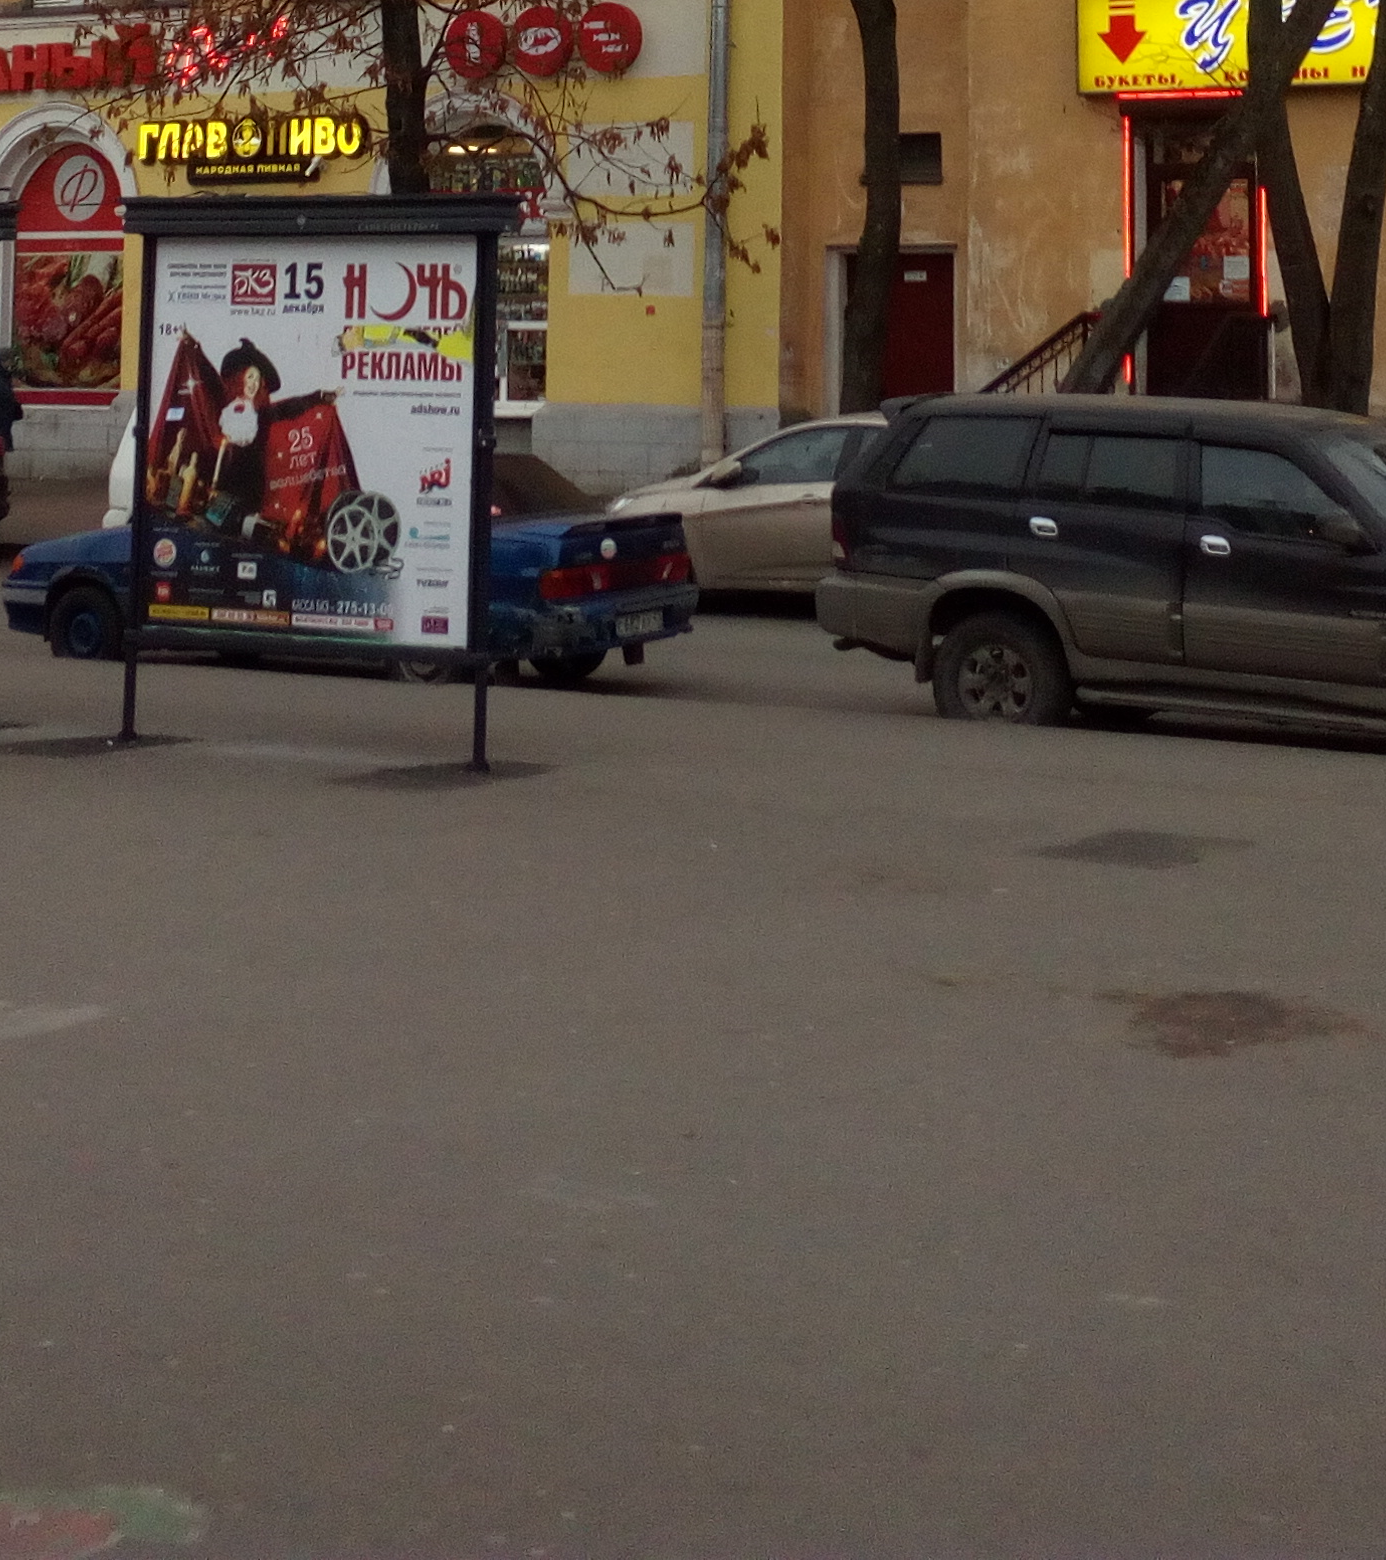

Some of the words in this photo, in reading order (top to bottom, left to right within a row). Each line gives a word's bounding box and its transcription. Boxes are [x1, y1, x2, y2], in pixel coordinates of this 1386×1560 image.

[1094, 72, 1183, 89] БУКЕТЫ,
[196, 163, 254, 176] НАРОДНАЯ
[257, 162, 301, 174] ПИВНАЯ
[283, 261, 325, 301] 15
[281, 301, 325, 316] декабря
[341, 350, 462, 383] РЕКЛАМЫ
[288, 425, 313, 454] 25
